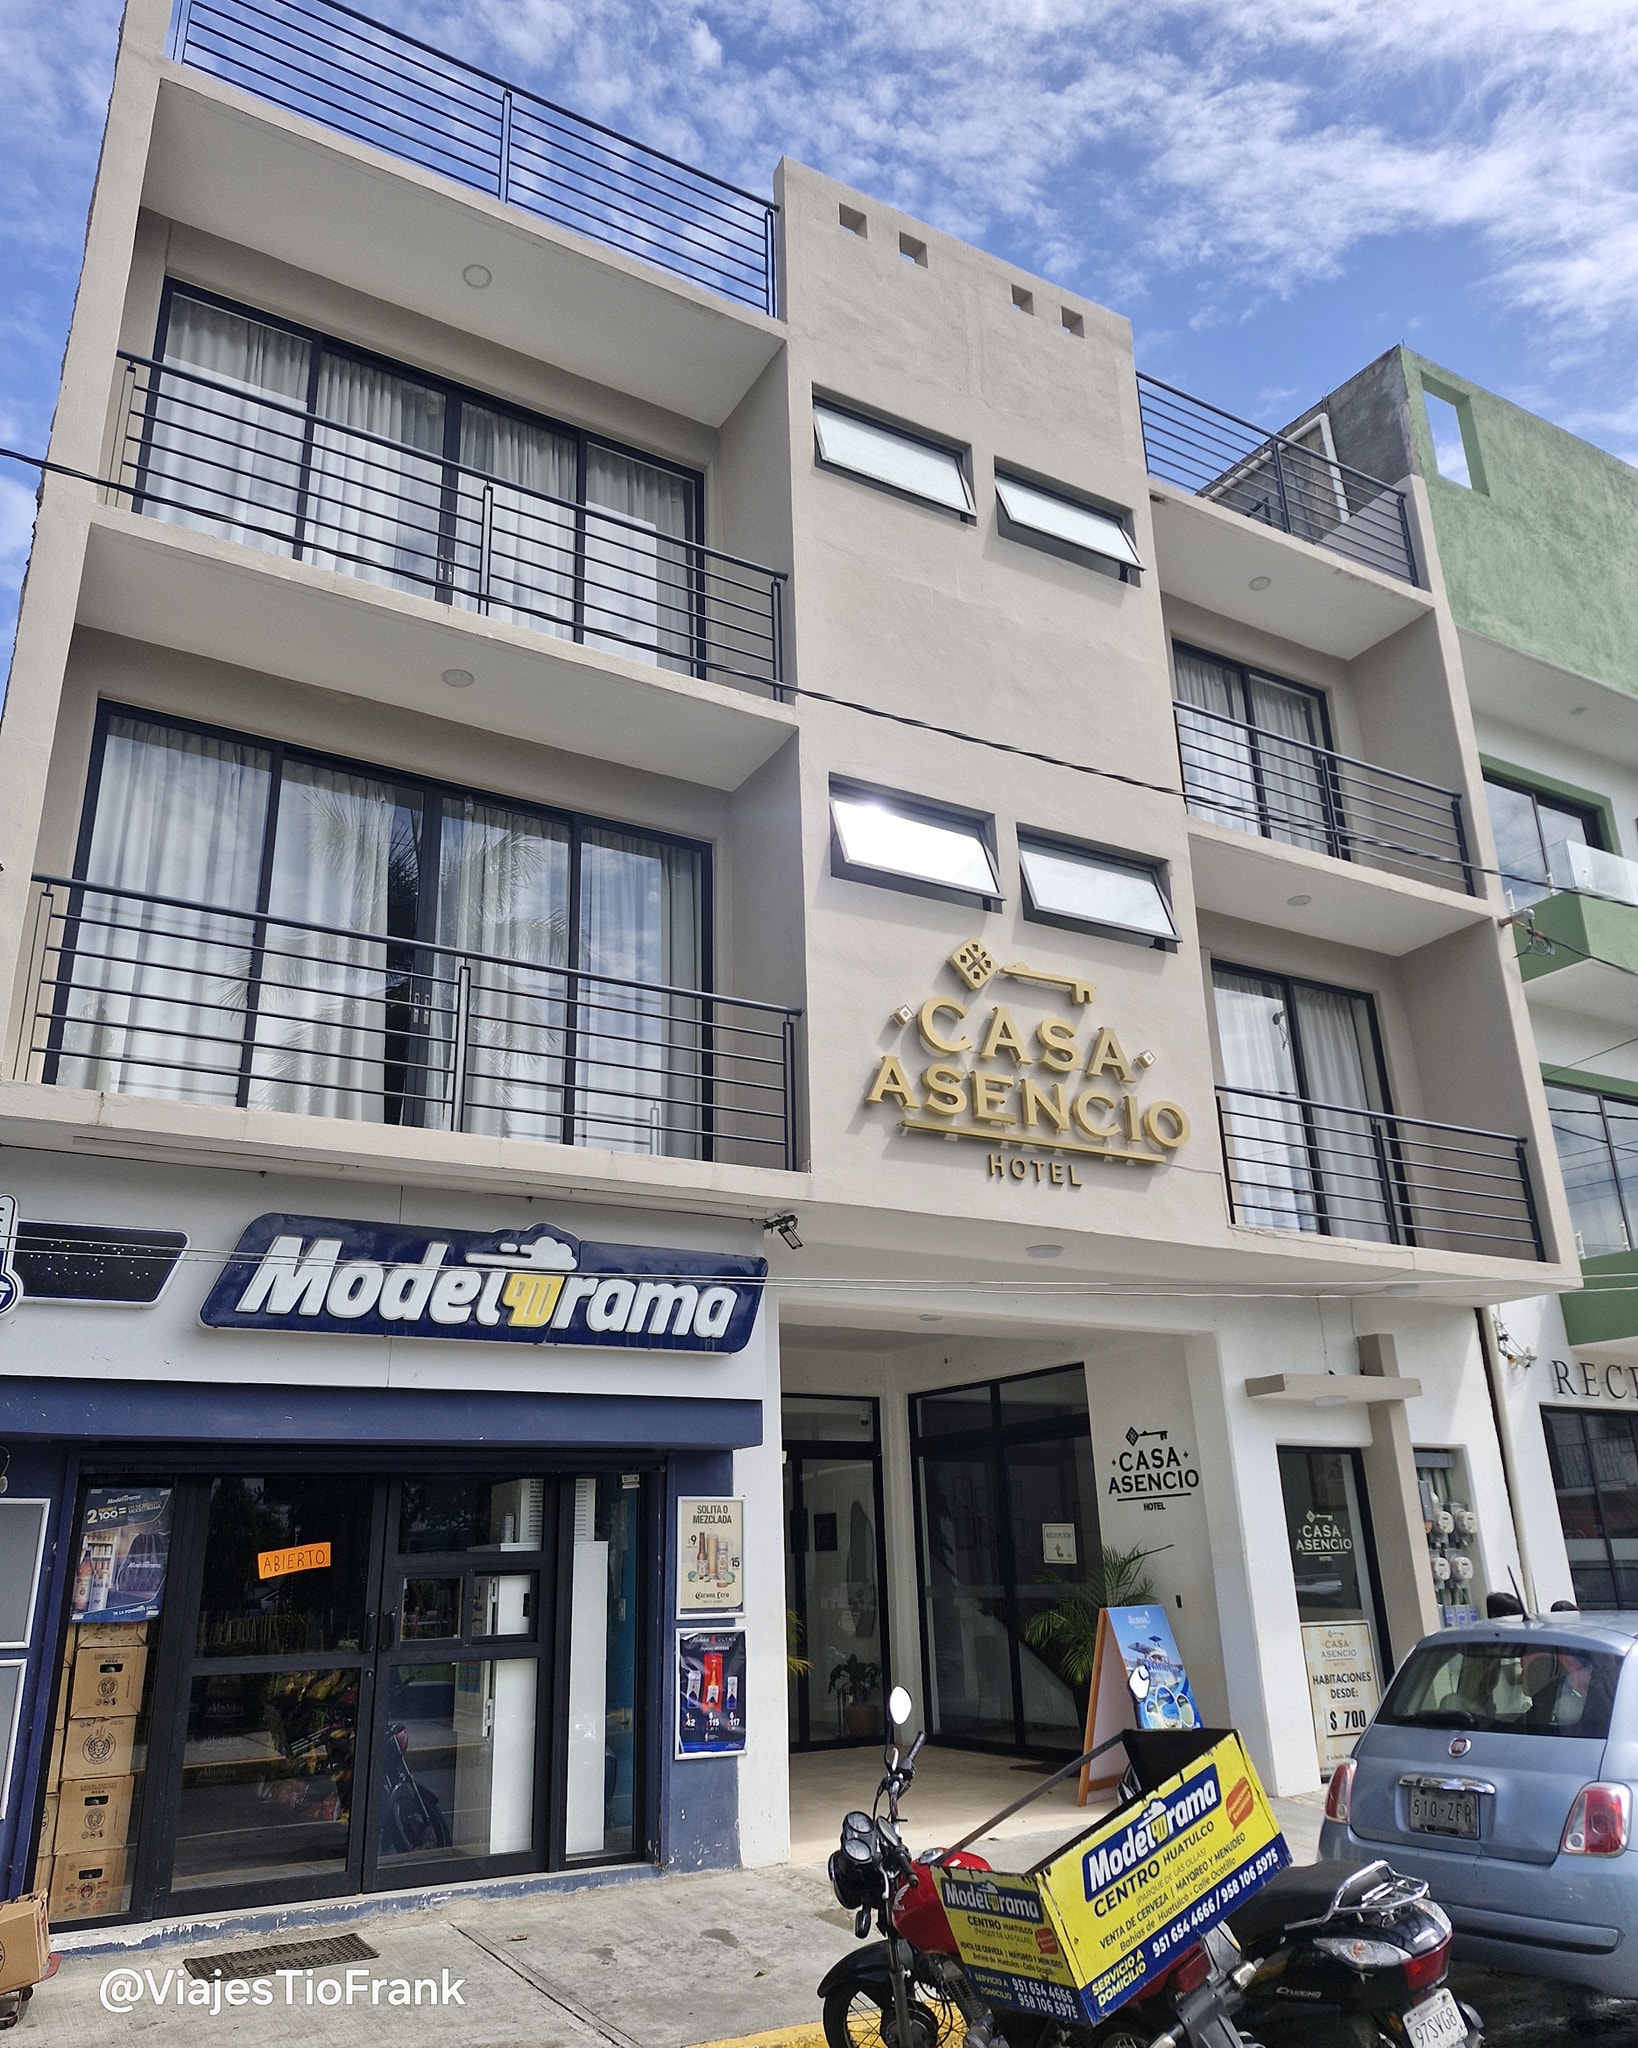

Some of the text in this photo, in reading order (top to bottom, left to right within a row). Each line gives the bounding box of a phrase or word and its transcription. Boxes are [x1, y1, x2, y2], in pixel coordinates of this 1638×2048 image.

[917, 996, 1137, 1084] CASA
[866, 1055, 1191, 1149] ASENCIO
[988, 1153, 1083, 1187] HOTEL
[1119, 1447, 1181, 1472] CASA
[1108, 1469, 1199, 1494] ASENCIO
[87, 1509, 98, 1524] 2
[99, 1510, 118, 1521] 100
[697, 1505, 728, 1514] SOLITA O
[1143, 1502, 1166, 1511] HOTEL
[693, 1515, 732, 1524] MEZCLADA
[1302, 1525, 1341, 1538] CASA
[1296, 1538, 1352, 1551] ASENCIO
[263, 1549, 326, 1573] ABIERTO
[1321, 1649, 1357, 1658] ASENCIO
[1325, 1640, 1350, 1648] CASA
[1312, 1671, 1372, 1686] HABITACIONES
[1330, 1688, 1359, 1699] DESDE:
[1330, 1710, 1367, 1731] $ 700
[1094, 1821, 1214, 1918] CENTRO HUATULCO
[1099, 1925, 1126, 1950] VENTA
[1125, 1916, 1137, 1931] DE
[1136, 1892, 1169, 1922] CERVEZA
[1175, 1861, 1208, 1892] MAYOREO
[1208, 1856, 1214, 1867] Y
[1214, 1832, 1246, 1862] MENUDEO
[1146, 1920, 1156, 1931] de
[1157, 1894, 1189, 1922] Huatulco
[1193, 1876, 1211, 1894] Calle
[1210, 1857, 1236, 1880] Ocotillo
[1152, 1933, 1171, 1958] 951
[1170, 1918, 1190, 1943] 654
[1191, 1897, 1216, 1926] 4666
[1221, 1879, 1240, 1903] 958
[1239, 1865, 1256, 1888] 106
[1256, 1847, 1278, 1875] 5975
[967, 1915, 1033, 1935] CENTRO HUATULCO
[975, 1972, 1002, 1986] SERVICIO
[1092, 1949, 1144, 1996] SERVICIO A
[1098, 1961, 1147, 2007] DOMICILIO
[1012, 1978, 1073, 2003] 951 654 4666
[1018, 1993, 1078, 2019] 958 106 5975
